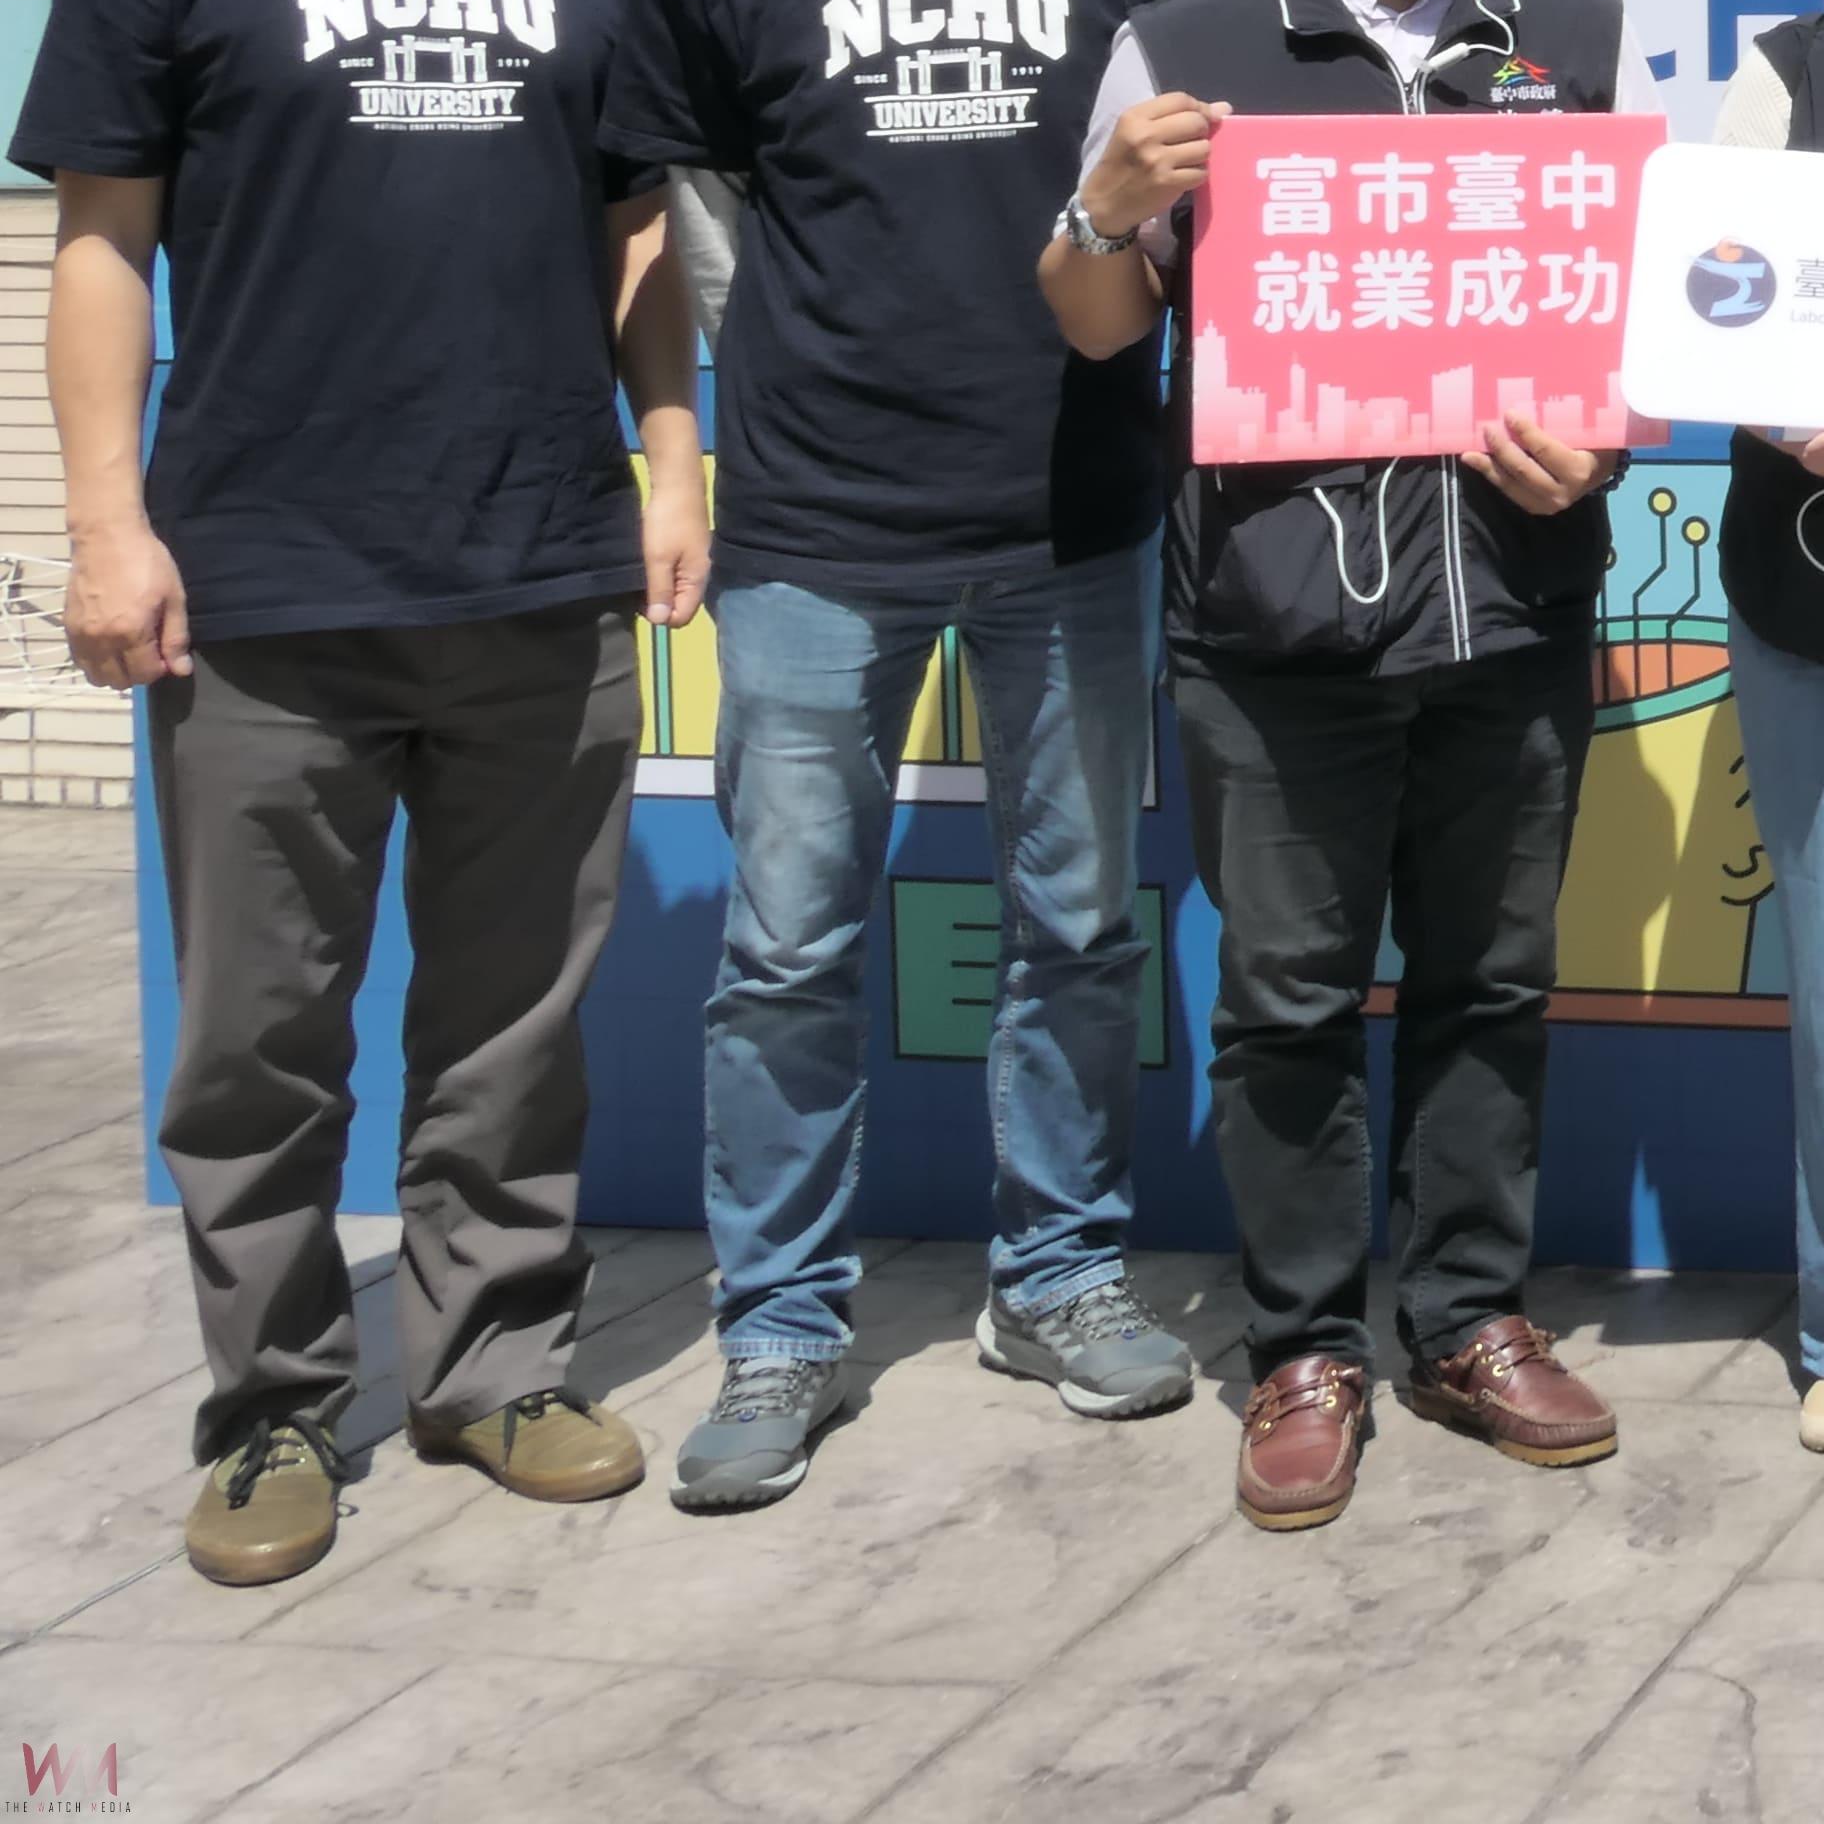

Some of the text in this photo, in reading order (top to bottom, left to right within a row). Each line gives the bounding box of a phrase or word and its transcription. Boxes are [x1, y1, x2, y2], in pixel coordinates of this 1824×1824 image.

[339, 57, 375, 69] SINCE
[497, 58, 530, 68] 1919
[1011, 65, 1043, 76] 1919
[853, 74, 888, 84] SINCE
[359, 87, 516, 116] UNIVERSITY
[873, 95, 1030, 128] UNIVERSITY
[1255, 150, 1616, 236] 富市臺中
[1253, 247, 1619, 333] 就業成功
